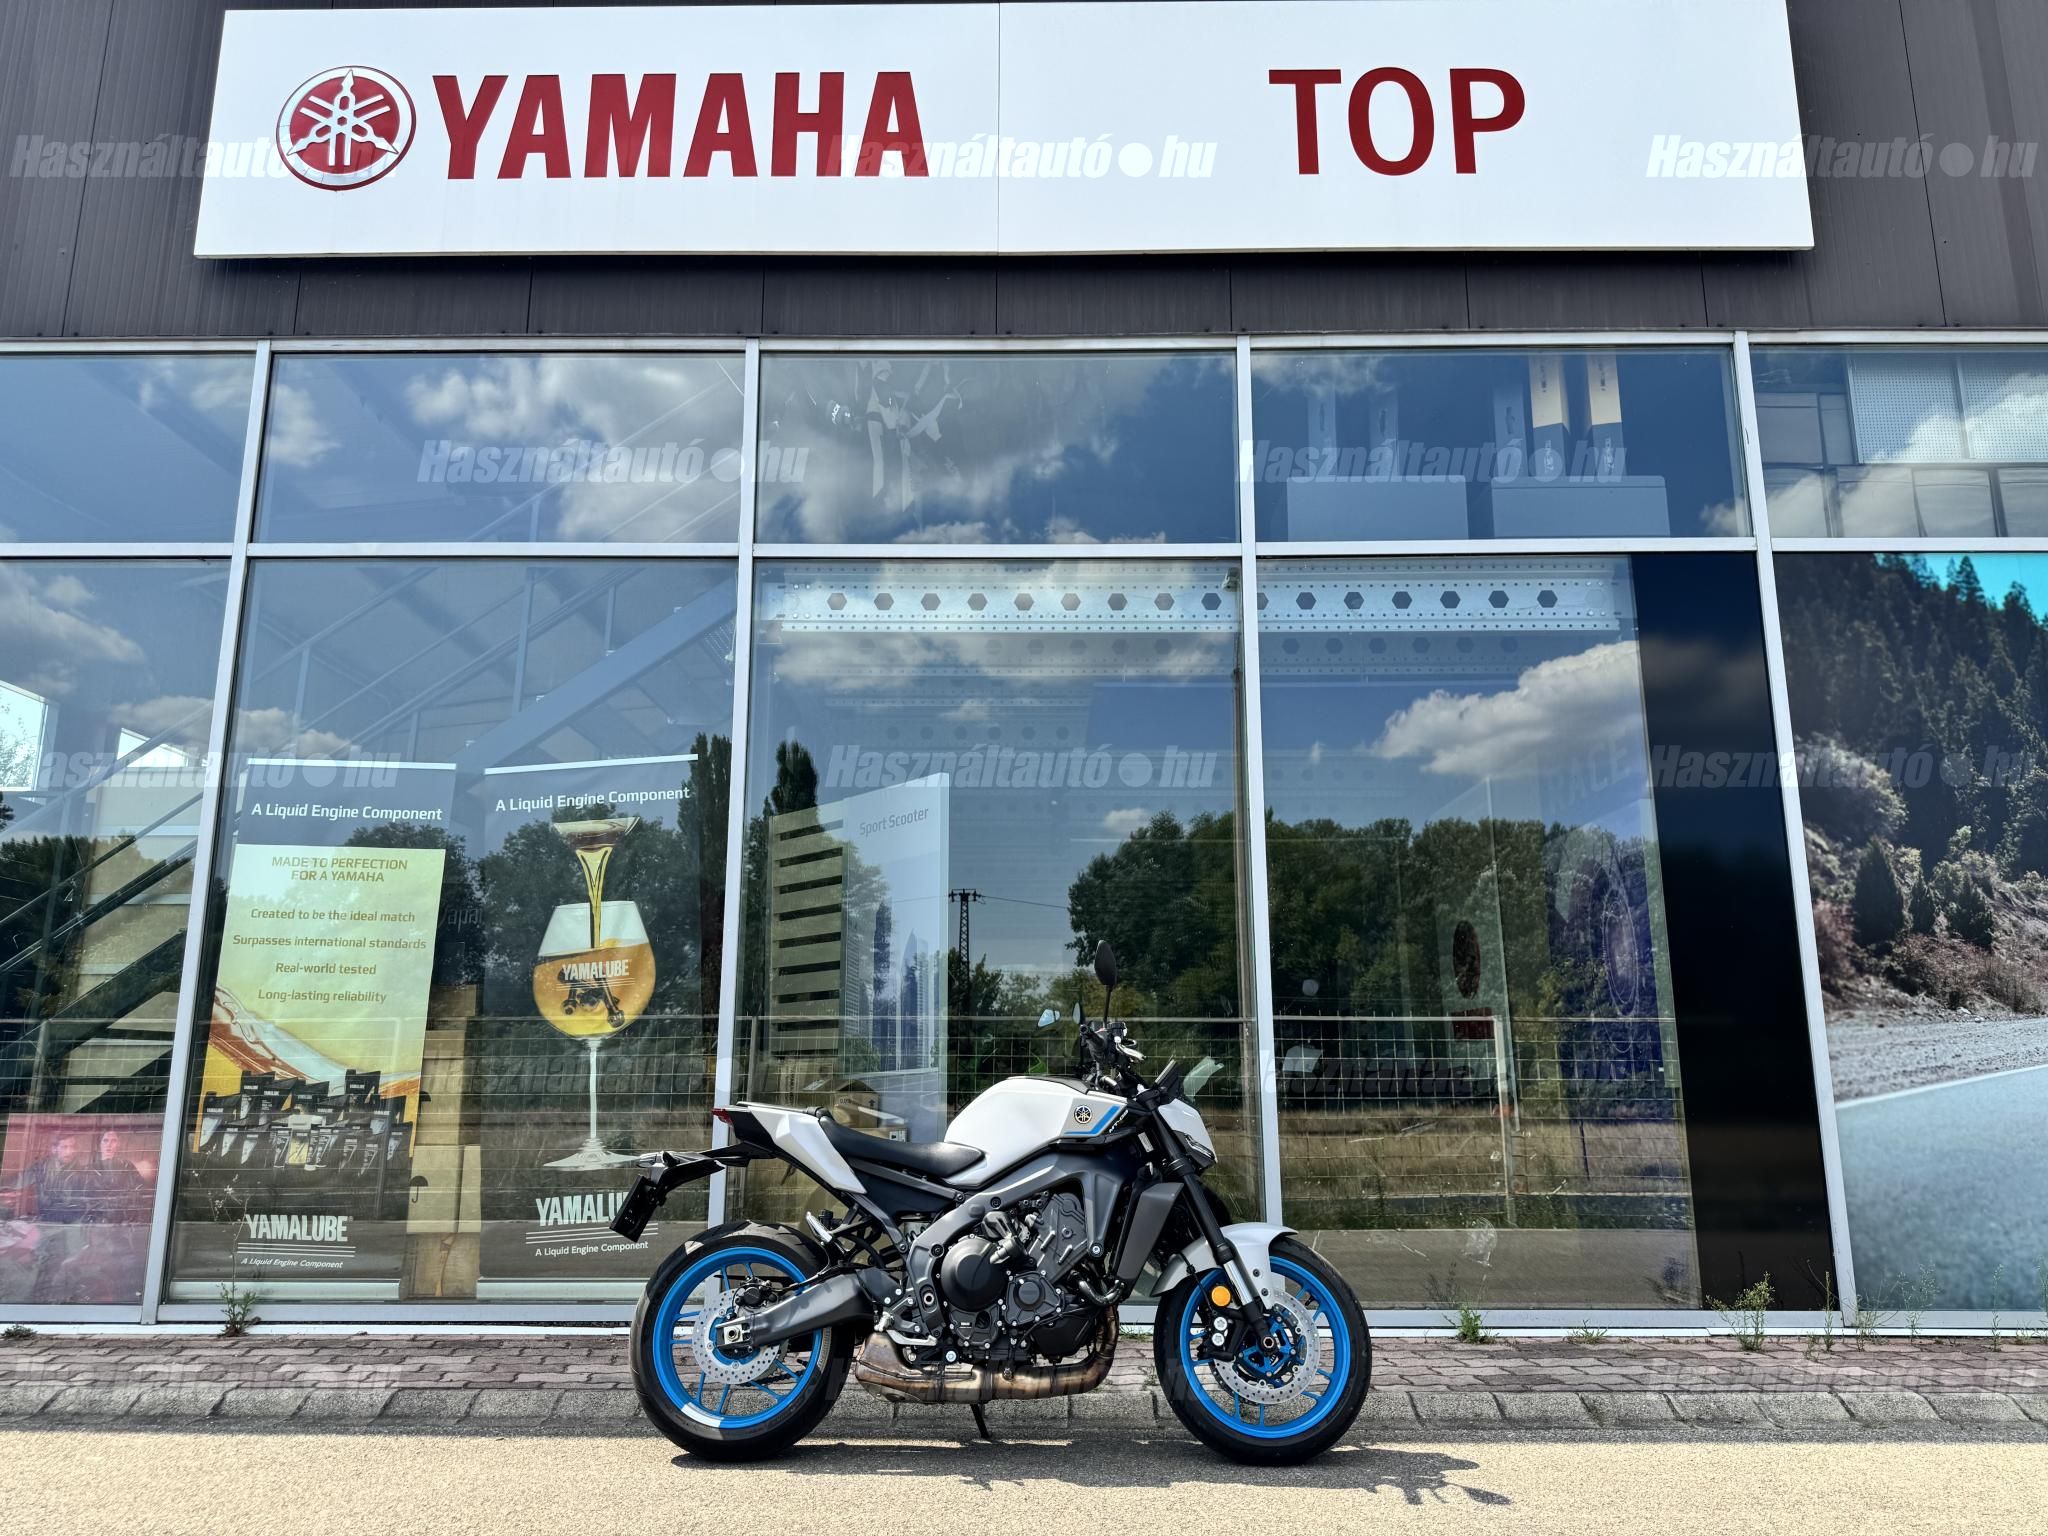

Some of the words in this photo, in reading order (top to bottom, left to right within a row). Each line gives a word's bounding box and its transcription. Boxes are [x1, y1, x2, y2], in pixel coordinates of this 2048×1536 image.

[432, 71, 930, 180] YAMAHA
[1269, 66, 1527, 176] TOP
[495, 799, 506, 812] A
[510, 795, 553, 812] Liquid
[557, 793, 605, 810] Engine
[608, 787, 690, 804] Component
[251, 803, 262, 816] A
[266, 803, 308, 820] Liquid
[311, 804, 359, 821] Engine
[362, 806, 443, 822] Component
[859, 817, 886, 837] Sport
[888, 808, 929, 828] Scooter
[271, 856, 309, 868] MADE
[312, 858, 328, 868] TO
[331, 858, 408, 870] PERFECTION
[291, 870, 317, 881] FOR
[319, 871, 328, 881] A
[331, 871, 385, 882] YAMAHA
[250, 908, 295, 920] Created
[299, 909, 310, 920] to
[312, 909, 325, 920] be
[328, 909, 347, 921] the
[350, 911, 378, 922] ideal
[380, 912, 415, 923] match
[233, 935, 291, 948] Surpasses
[294, 936, 366, 948] international
[369, 938, 427, 950] standards
[275, 962, 336, 974] Real-world
[339, 963, 376, 975] tested
[562, 959, 629, 980] YAMALUBE
[258, 989, 330, 1004] Long-lasting
[333, 991, 387, 1004] reliability
[535, 1191, 629, 1227] YAMALU
[245, 1214, 349, 1242] YAMALUBE
[534, 1248, 542, 1256] A
[544, 1246, 569, 1257] Liquid
[571, 1244, 599, 1255] Engine
[601, 1241, 649, 1252] Component
[249, 1258, 272, 1266] Liquid
[273, 1259, 299, 1267] Engine
[300, 1260, 343, 1268] Component
